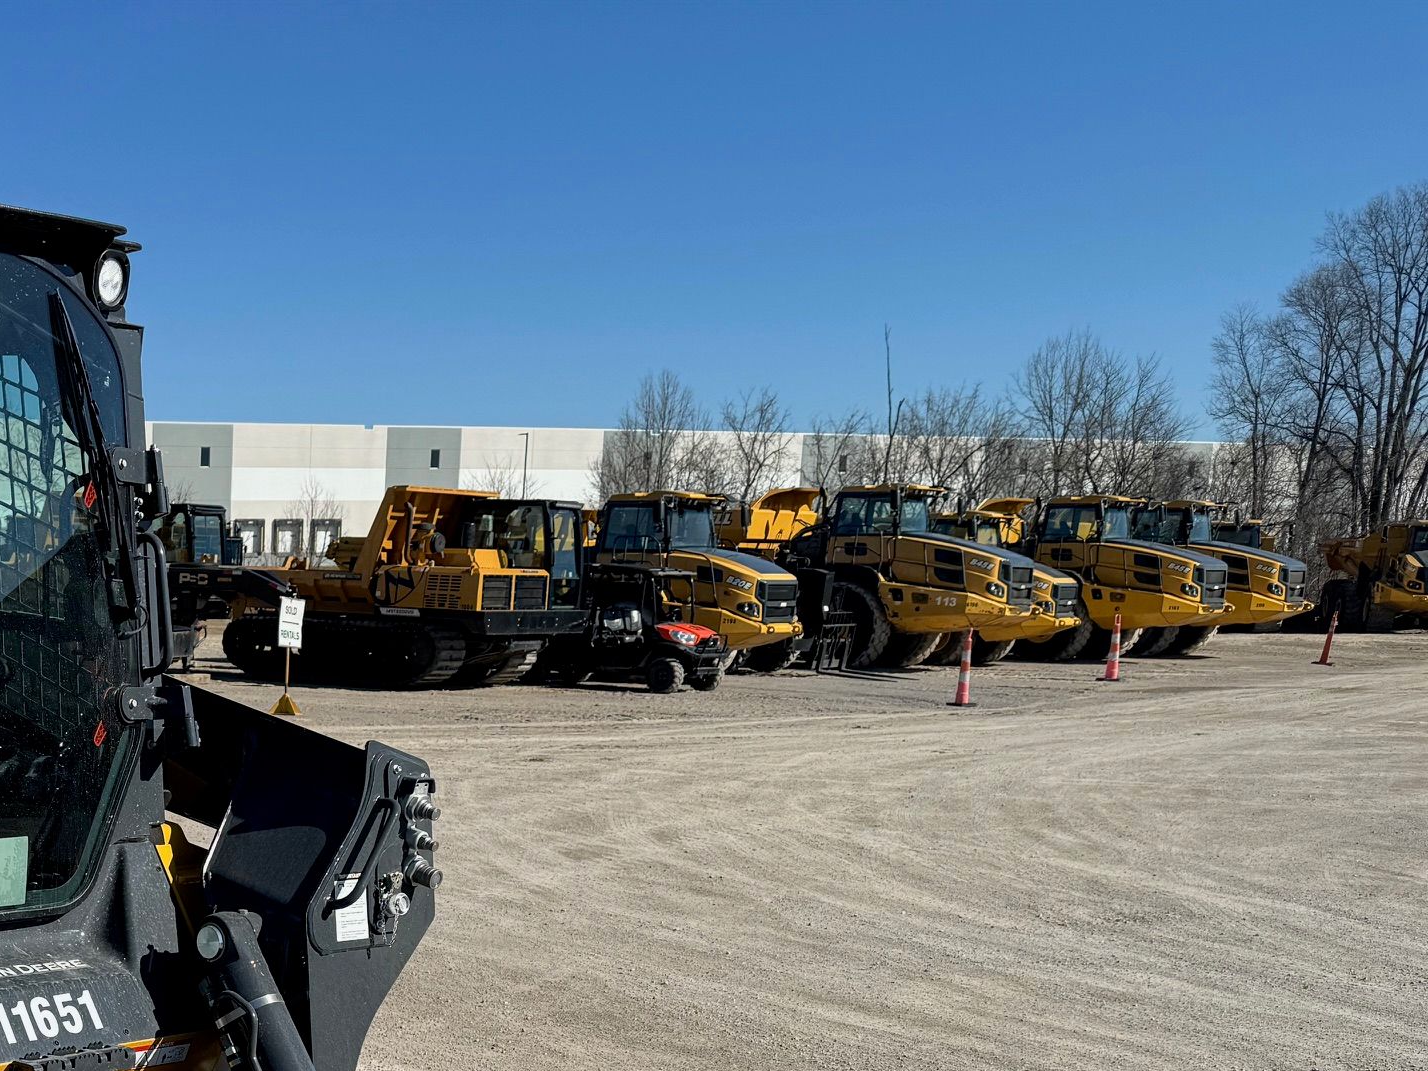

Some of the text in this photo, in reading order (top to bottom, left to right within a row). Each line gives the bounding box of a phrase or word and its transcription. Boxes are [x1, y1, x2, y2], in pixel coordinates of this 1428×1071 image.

[935, 596, 957, 607] 113
[285, 605, 298, 616] SOLD
[280, 629, 300, 641] RENTALS
[13, 959, 87, 974] DEERE
